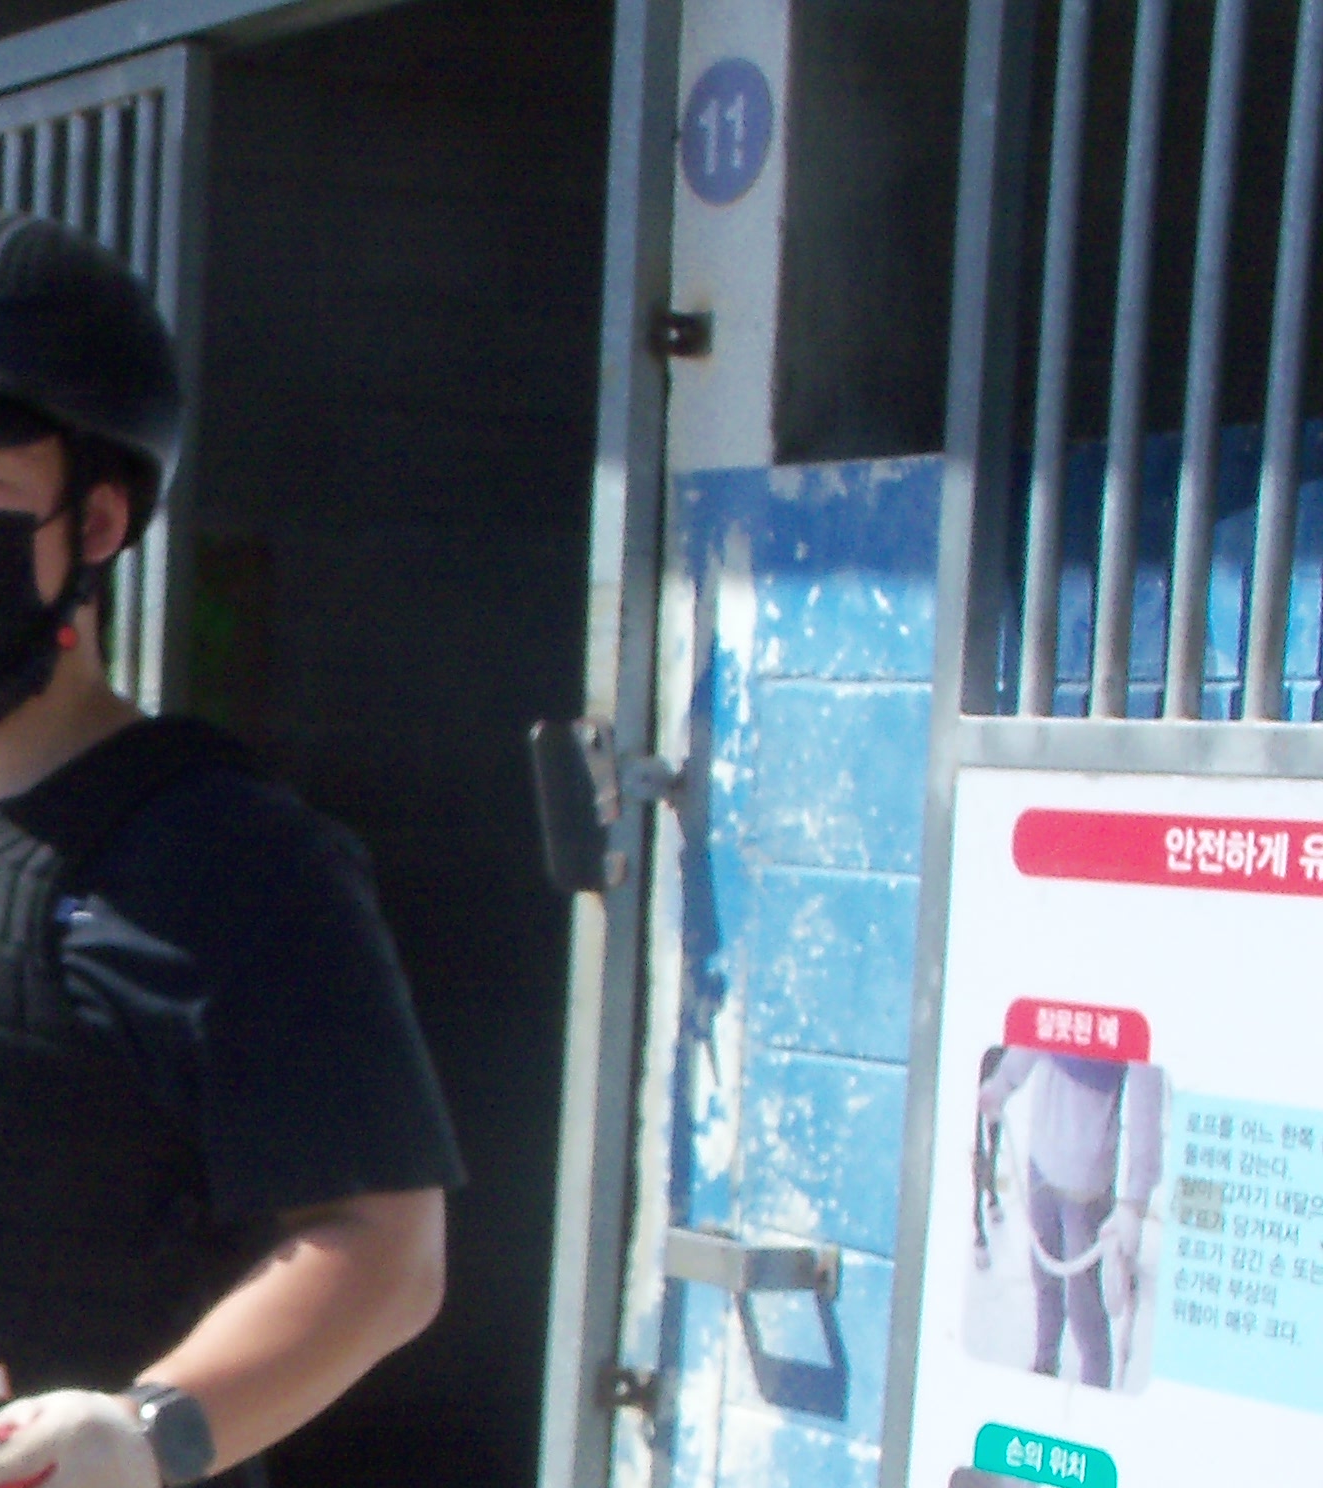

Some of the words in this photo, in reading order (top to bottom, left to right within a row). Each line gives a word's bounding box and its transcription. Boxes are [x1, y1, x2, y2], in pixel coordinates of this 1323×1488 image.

[696, 92, 746, 176] 11
[1165, 826, 1290, 879] 안전하게
[1241, 1119, 1275, 1145] 어느
[1005, 1435, 1044, 1473] 손의
[1048, 1445, 1087, 1485] 위치
